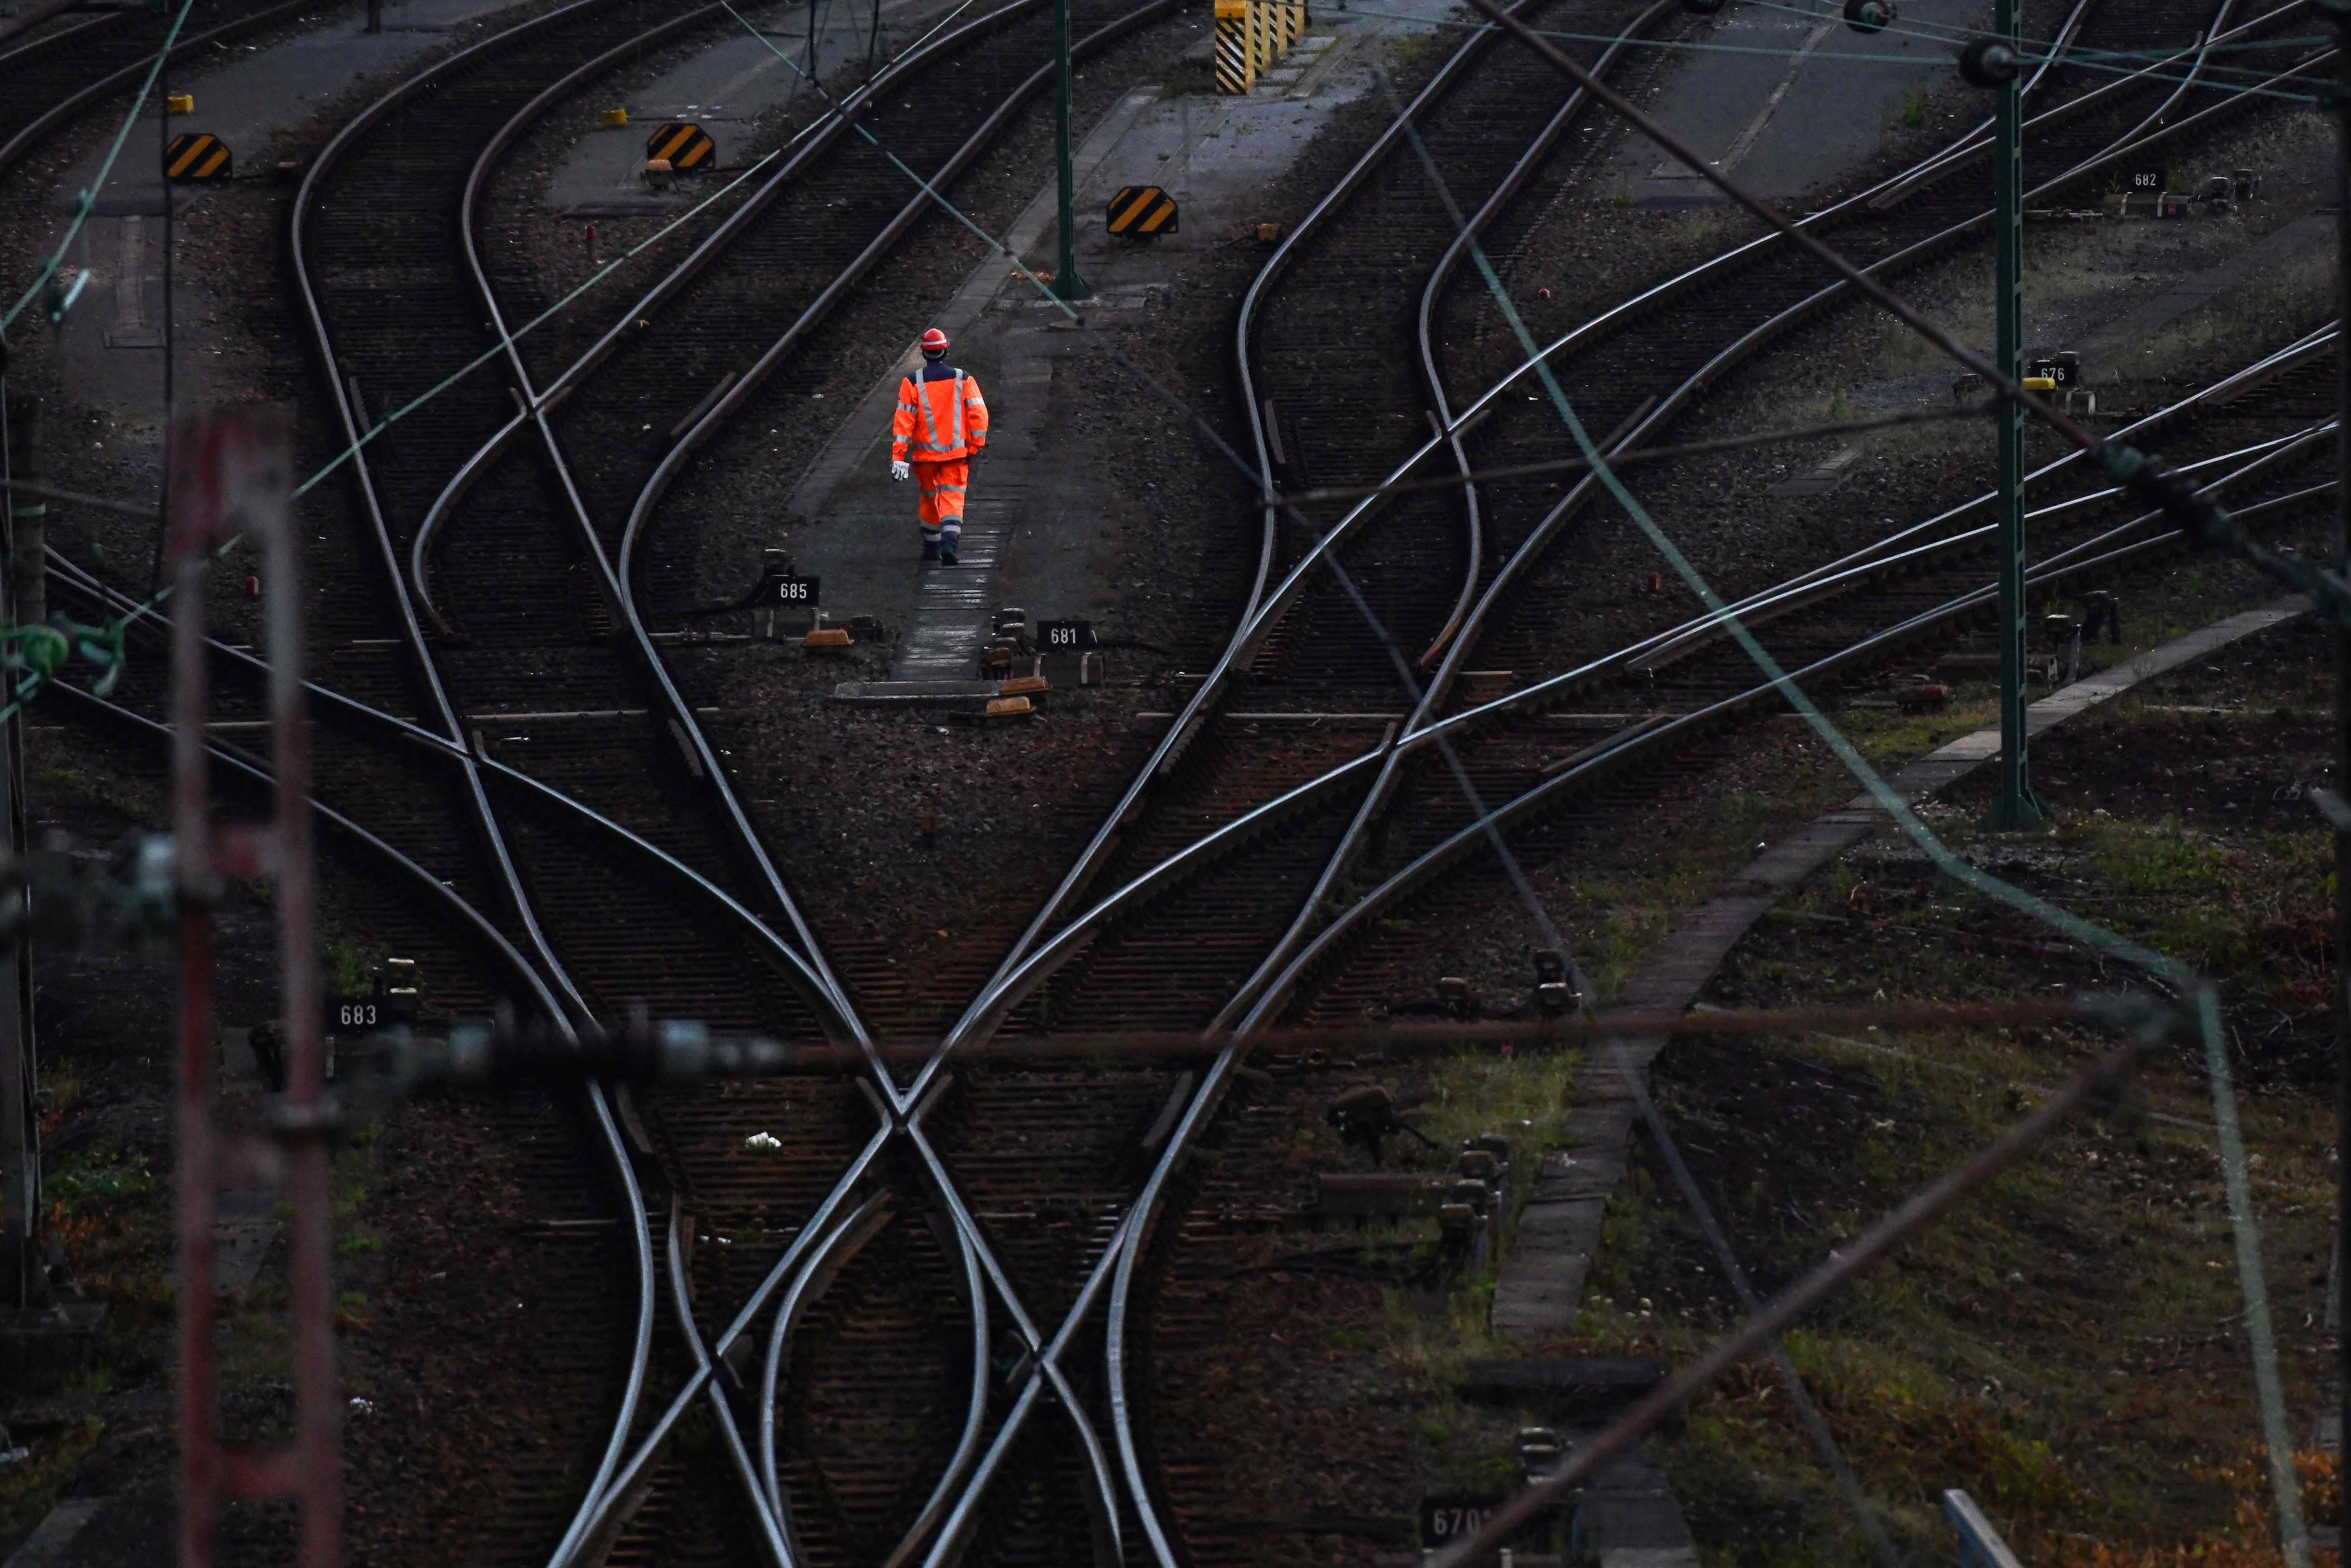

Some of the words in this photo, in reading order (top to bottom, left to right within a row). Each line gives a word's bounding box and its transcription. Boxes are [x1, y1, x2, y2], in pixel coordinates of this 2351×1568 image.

[2135, 174, 2156, 186] 682
[2041, 367, 2065, 381] 676
[781, 583, 807, 599] 685
[1051, 628, 1076, 644] 681
[341, 1005, 376, 1025] 683
